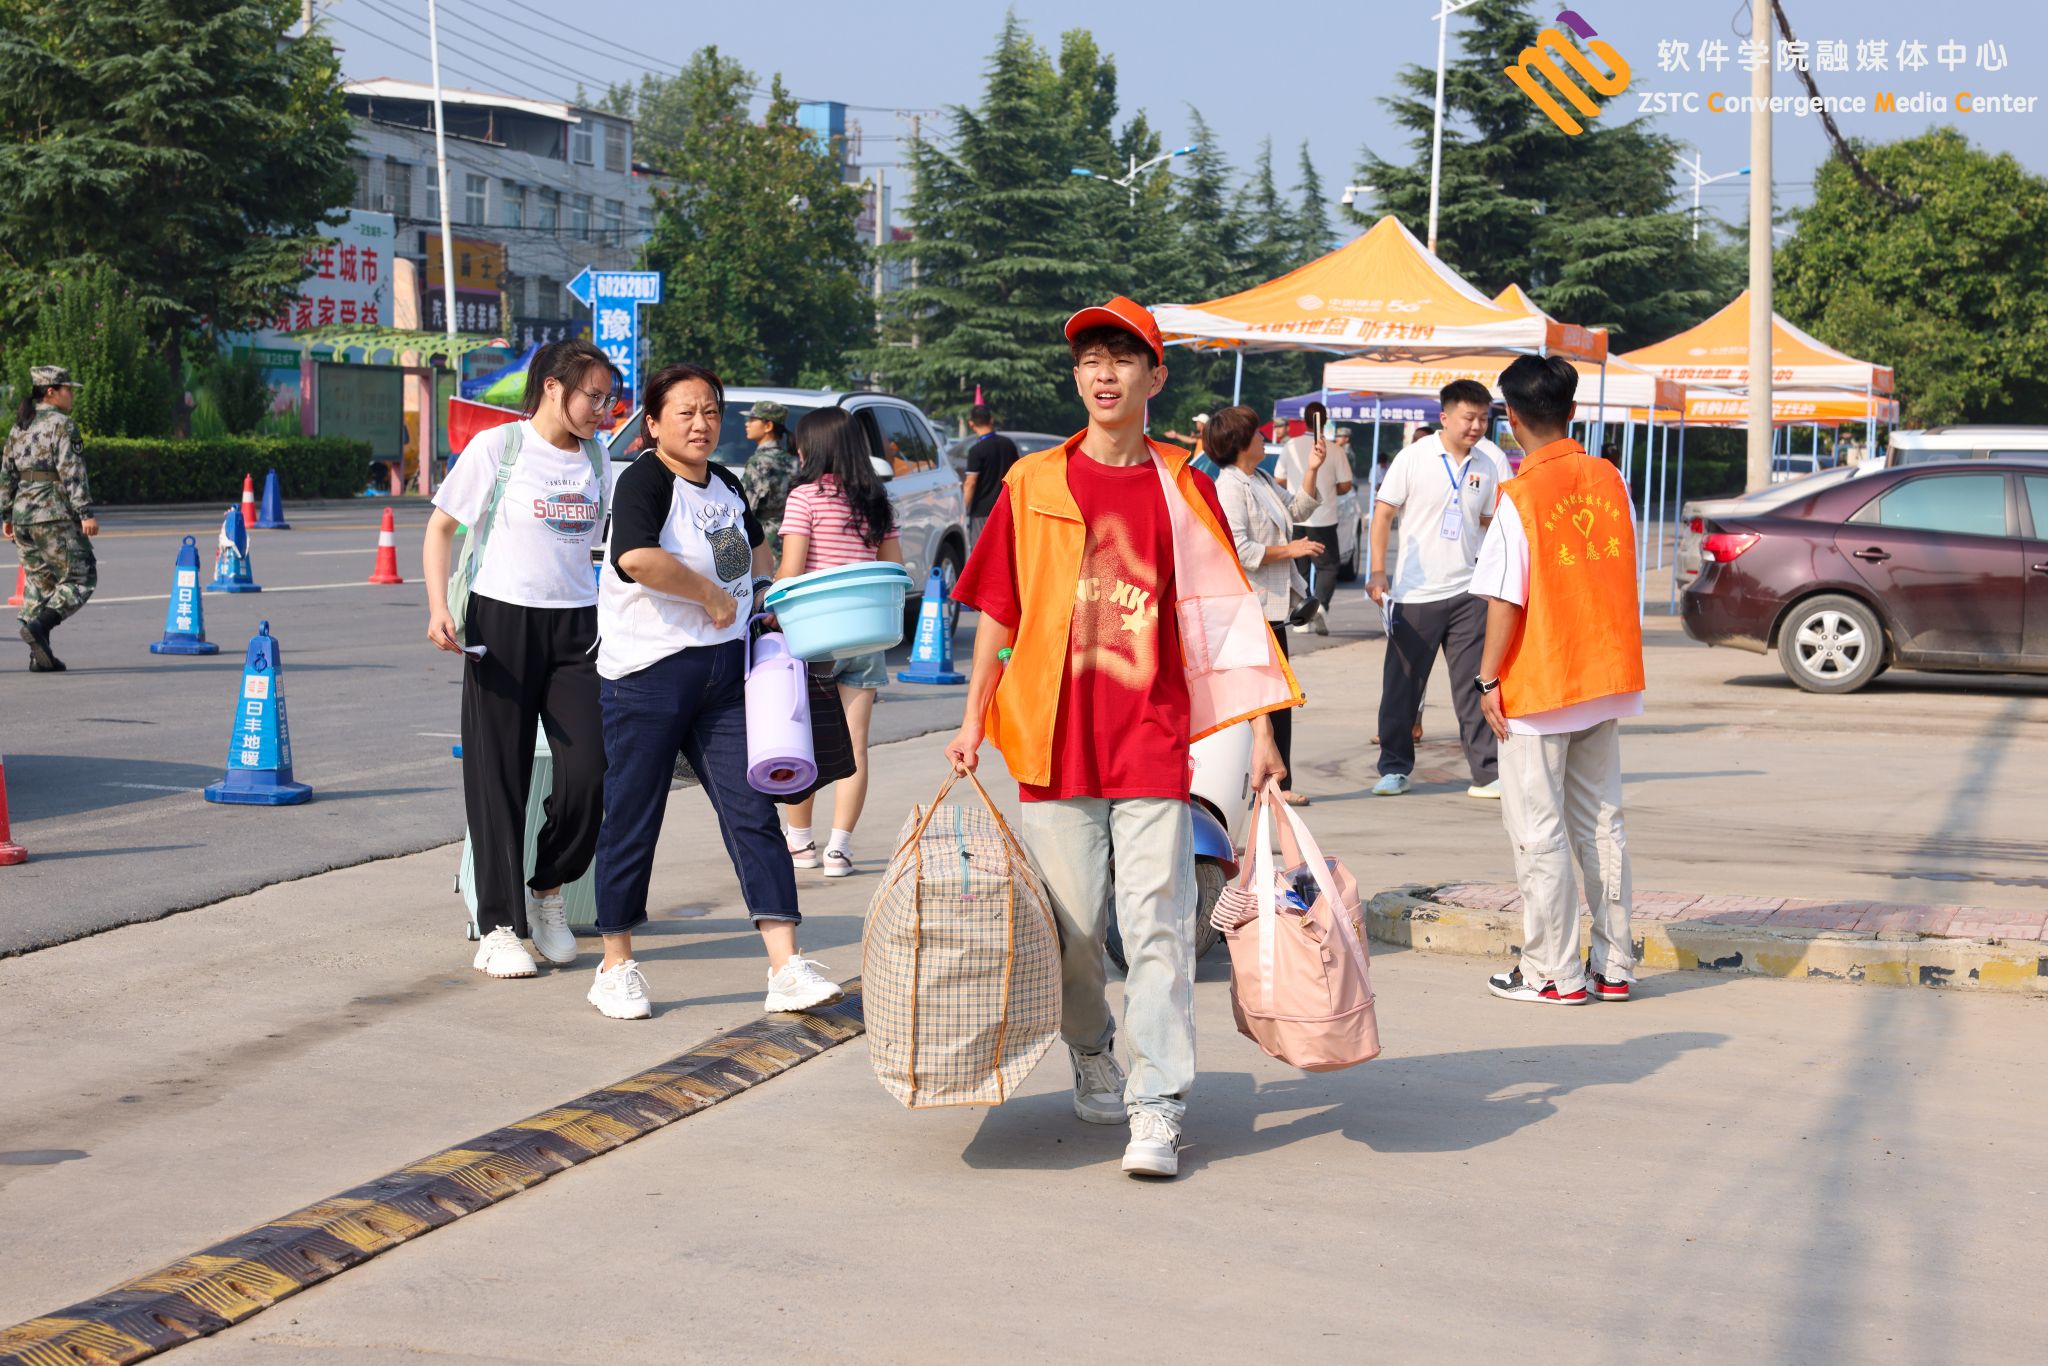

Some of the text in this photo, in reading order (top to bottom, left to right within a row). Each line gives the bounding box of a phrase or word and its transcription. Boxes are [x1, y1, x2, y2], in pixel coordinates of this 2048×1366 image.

[432, 298, 498, 331] 汽美容装饰
[599, 308, 632, 387] 豫兴
[1558, 535, 1621, 567] 志愿者
[176, 588, 193, 631] 日丰管
[241, 702, 263, 766] 日丰地暖
